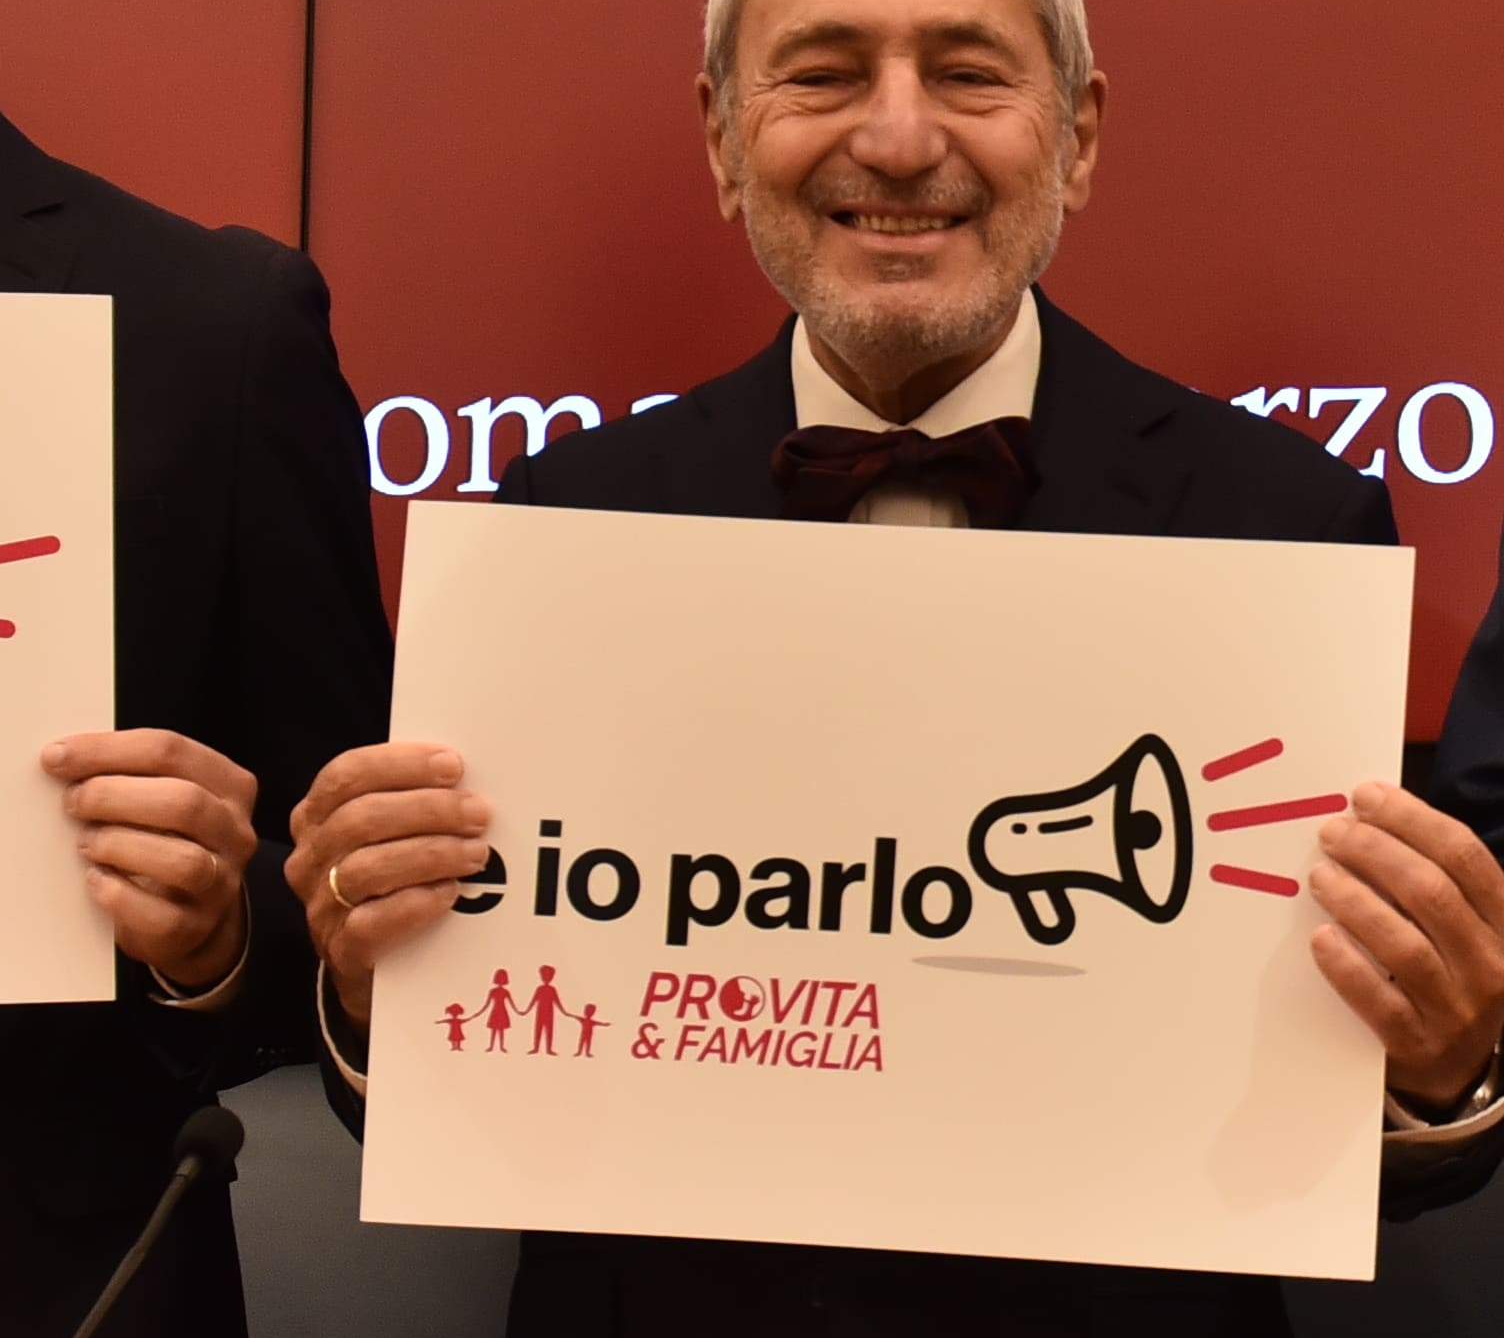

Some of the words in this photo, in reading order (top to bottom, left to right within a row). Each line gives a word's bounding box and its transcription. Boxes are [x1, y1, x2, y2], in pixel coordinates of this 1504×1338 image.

[533, 818, 642, 923] io
[664, 836, 975, 948] parlo
[631, 1024, 664, 1060] &
[673, 1026, 884, 1072] FAMIGLIA
